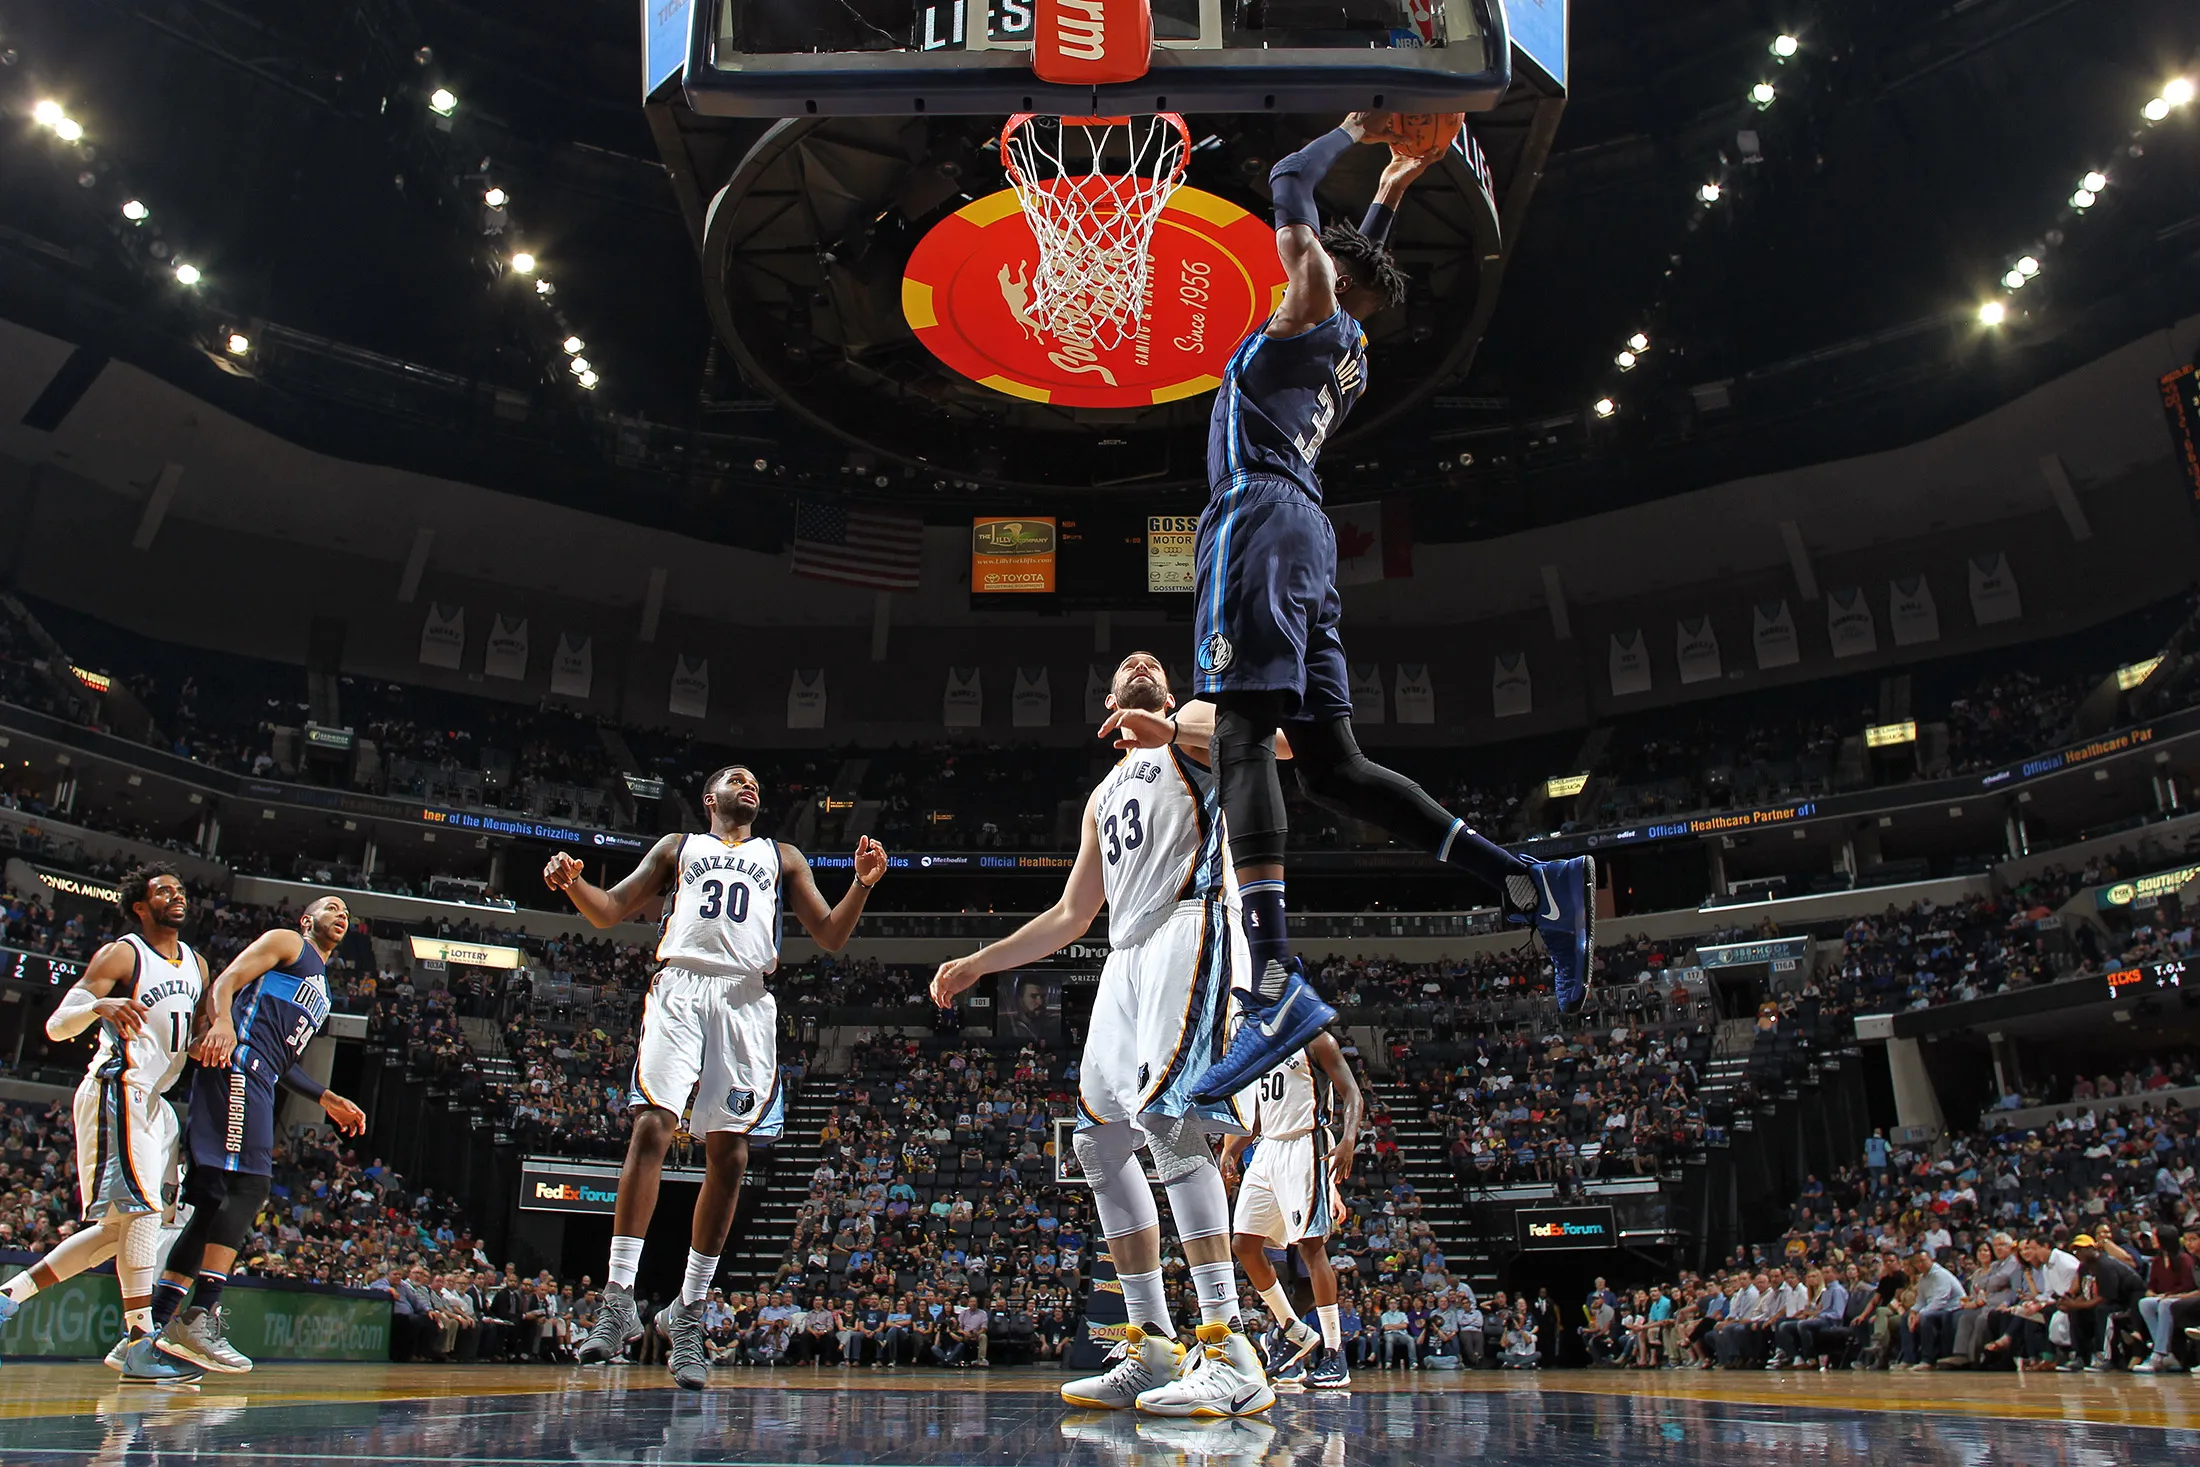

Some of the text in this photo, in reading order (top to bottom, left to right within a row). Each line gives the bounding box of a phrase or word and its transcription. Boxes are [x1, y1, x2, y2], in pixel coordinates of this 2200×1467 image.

[1394, 38, 1420, 49] NBA
[1141, 312, 1152, 321] &
[1172, 257, 1212, 355] Since 1956
[1134, 325, 1152, 367] GAMING
[1294, 383, 1335, 465] 3
[1149, 517, 1197, 532] GOSS
[978, 533, 991, 541] THE
[1017, 537, 1049, 546] COMPANY
[1152, 536, 1192, 545] MOTOR
[1001, 573, 1044, 582] TOYOTA
[2021, 755, 2064, 777] Official
[2064, 735, 2129, 764] Healthcare
[448, 812, 461, 825] of
[462, 814, 480, 827] the
[482, 816, 533, 836] Memphis
[534, 825, 581, 842] Grizzlies
[1103, 798, 1144, 866] 33
[1647, 824, 1687, 839] Official
[1689, 813, 1750, 833] Healthcare
[1752, 808, 1795, 824] Partner
[932, 856, 1074, 867] Methodist Official Healthcare
[38, 872, 80, 894] ONICA
[683, 855, 772, 891] GRIZZLIES
[699, 878, 751, 924] 30
[19, 952, 28, 964] F
[450, 948, 489, 961] LOTTERY
[14, 964, 60, 985] 2 5
[286, 1015, 316, 1056] 34
[1261, 1071, 1285, 1102] 50
[225, 1073, 246, 1153] MAVERICKS
[1095, 1282, 1121, 1290] SONIC
[1091, 1327, 1127, 1337] SONIC
